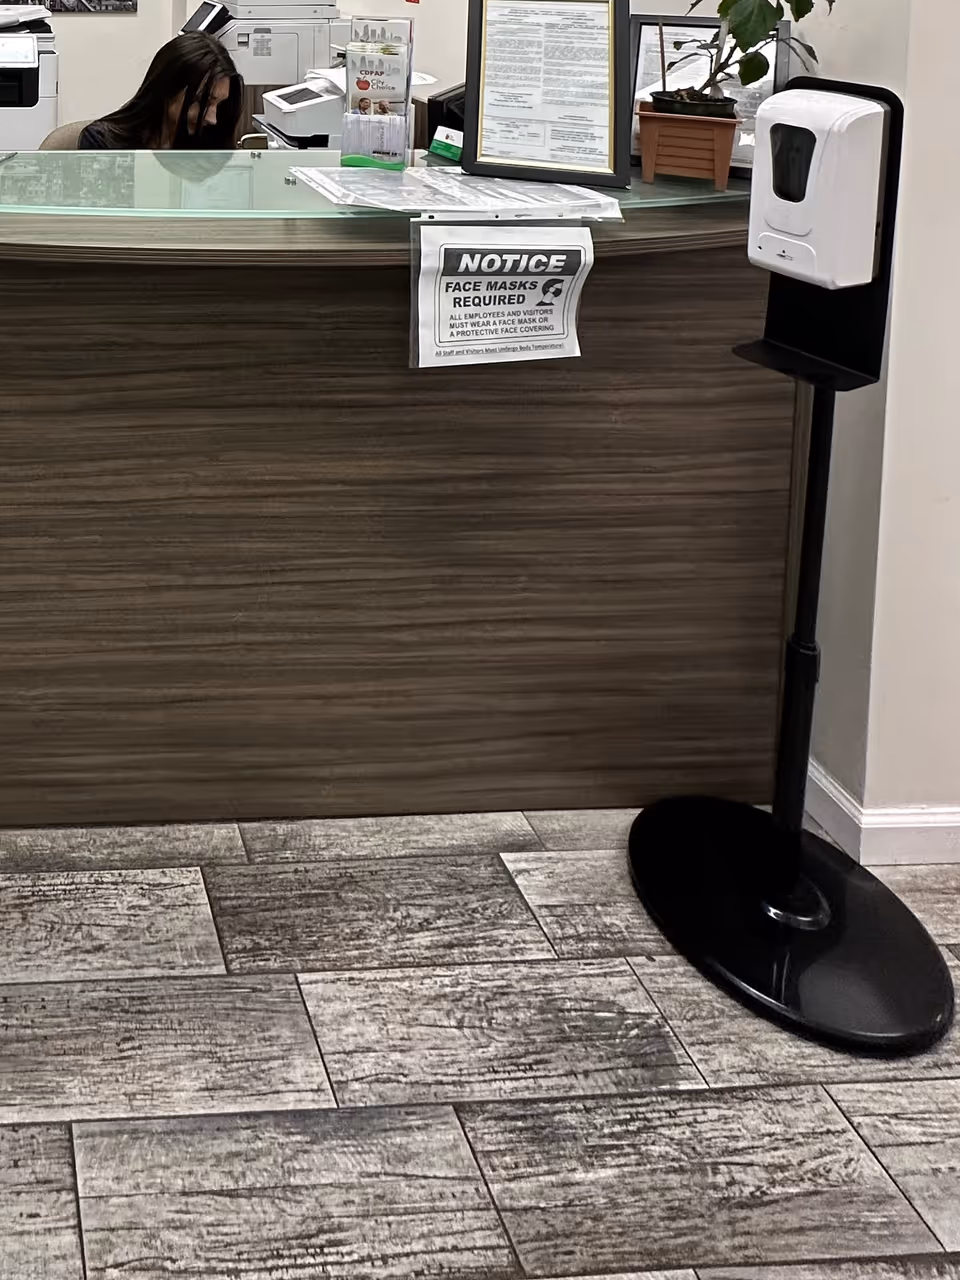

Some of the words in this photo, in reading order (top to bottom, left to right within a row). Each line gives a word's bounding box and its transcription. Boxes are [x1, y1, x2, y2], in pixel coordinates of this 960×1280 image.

[457, 253, 567, 273] NOTICE
[445, 281, 482, 293] FACE
[486, 280, 539, 291] MASKS
[453, 294, 526, 308] REQUIRED
[449, 313, 463, 321] ALL
[464, 311, 505, 320] EMPLOYEES
[523, 308, 554, 316] VISITORS
[470, 320, 491, 328] WEAR
[538, 316, 549, 324] OR
[449, 330, 456, 338] A
[456, 329, 499, 337] PROTECTIVE
[520, 324, 555, 333] COVERING
